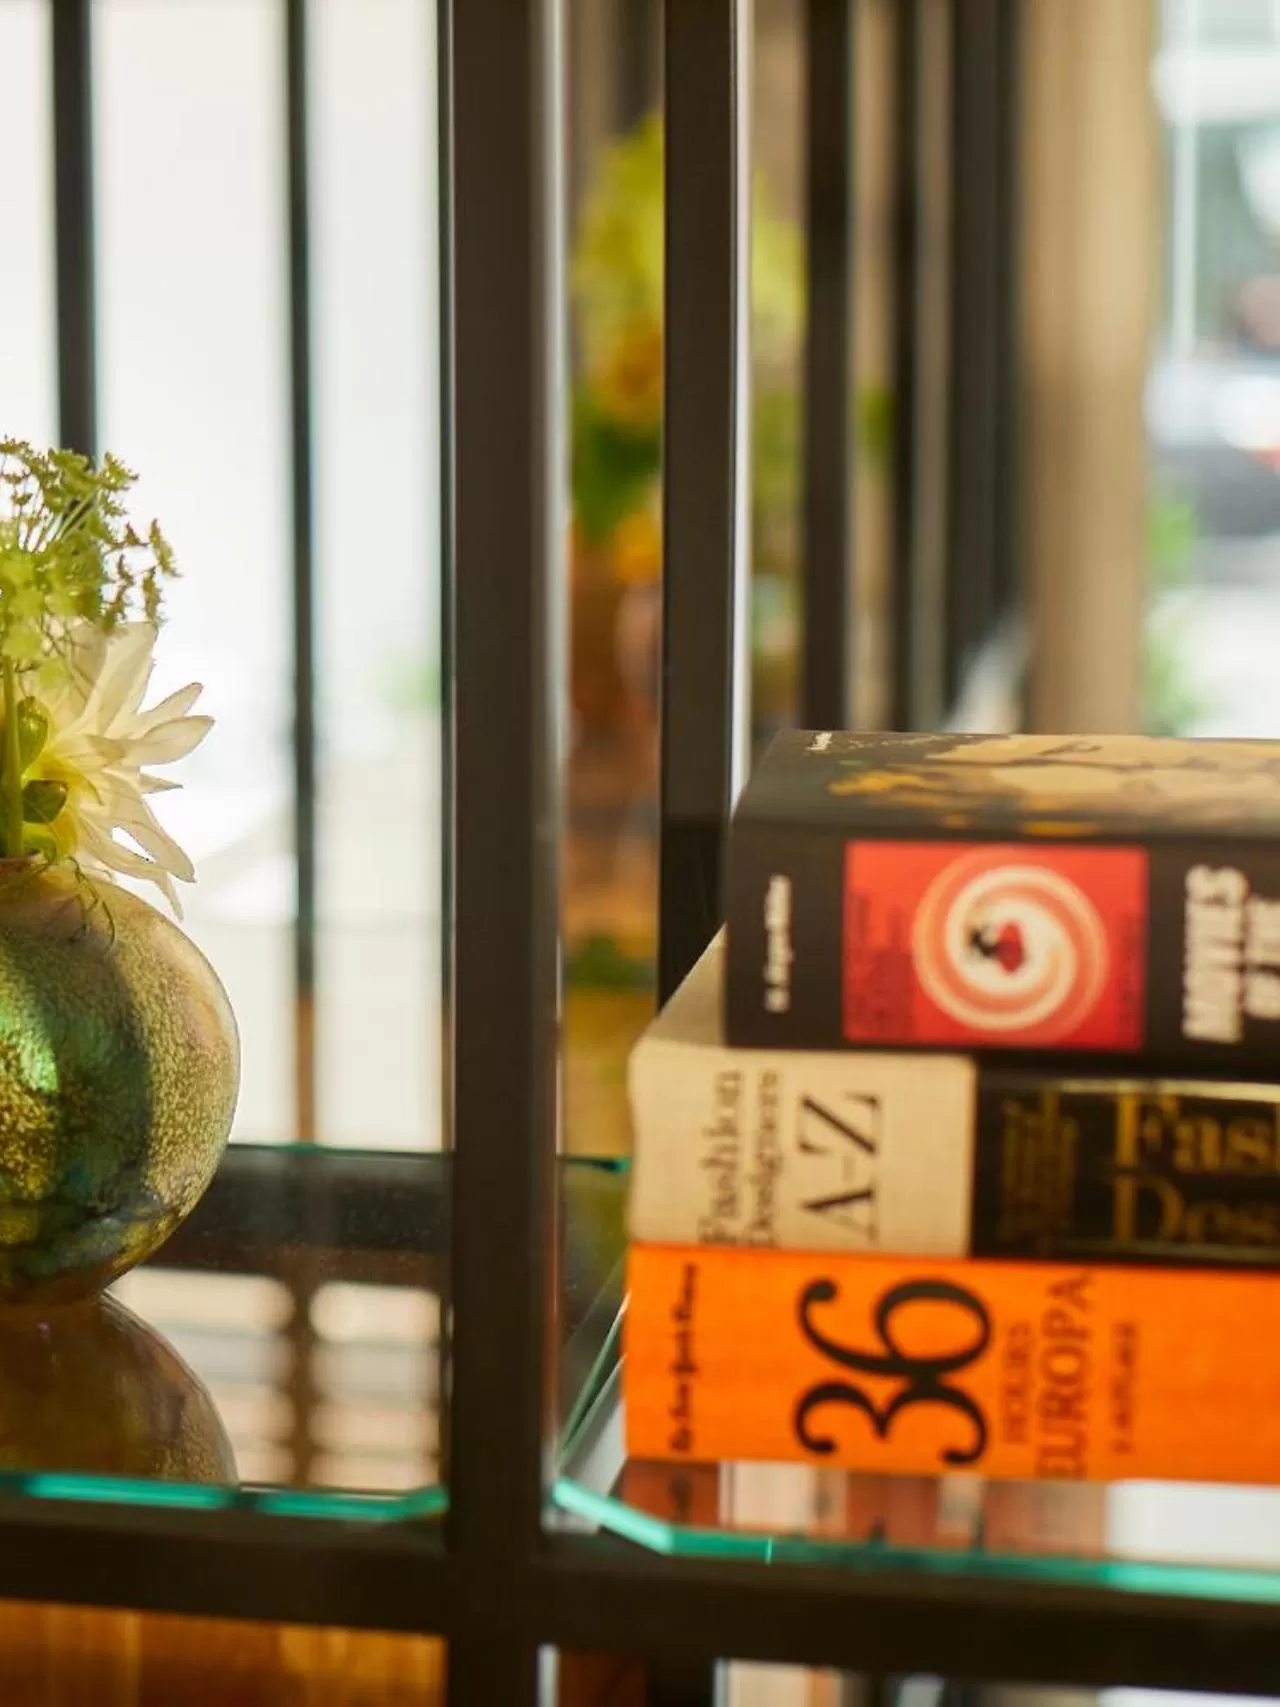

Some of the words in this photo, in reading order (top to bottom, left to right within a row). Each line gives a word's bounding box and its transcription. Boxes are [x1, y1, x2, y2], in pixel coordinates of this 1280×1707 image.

[698, 1070, 741, 1245] Fashion
[798, 1092, 880, 1244] A-Z
[1116, 1090, 1280, 1173] Fas
[792, 1277, 991, 1466] 36
